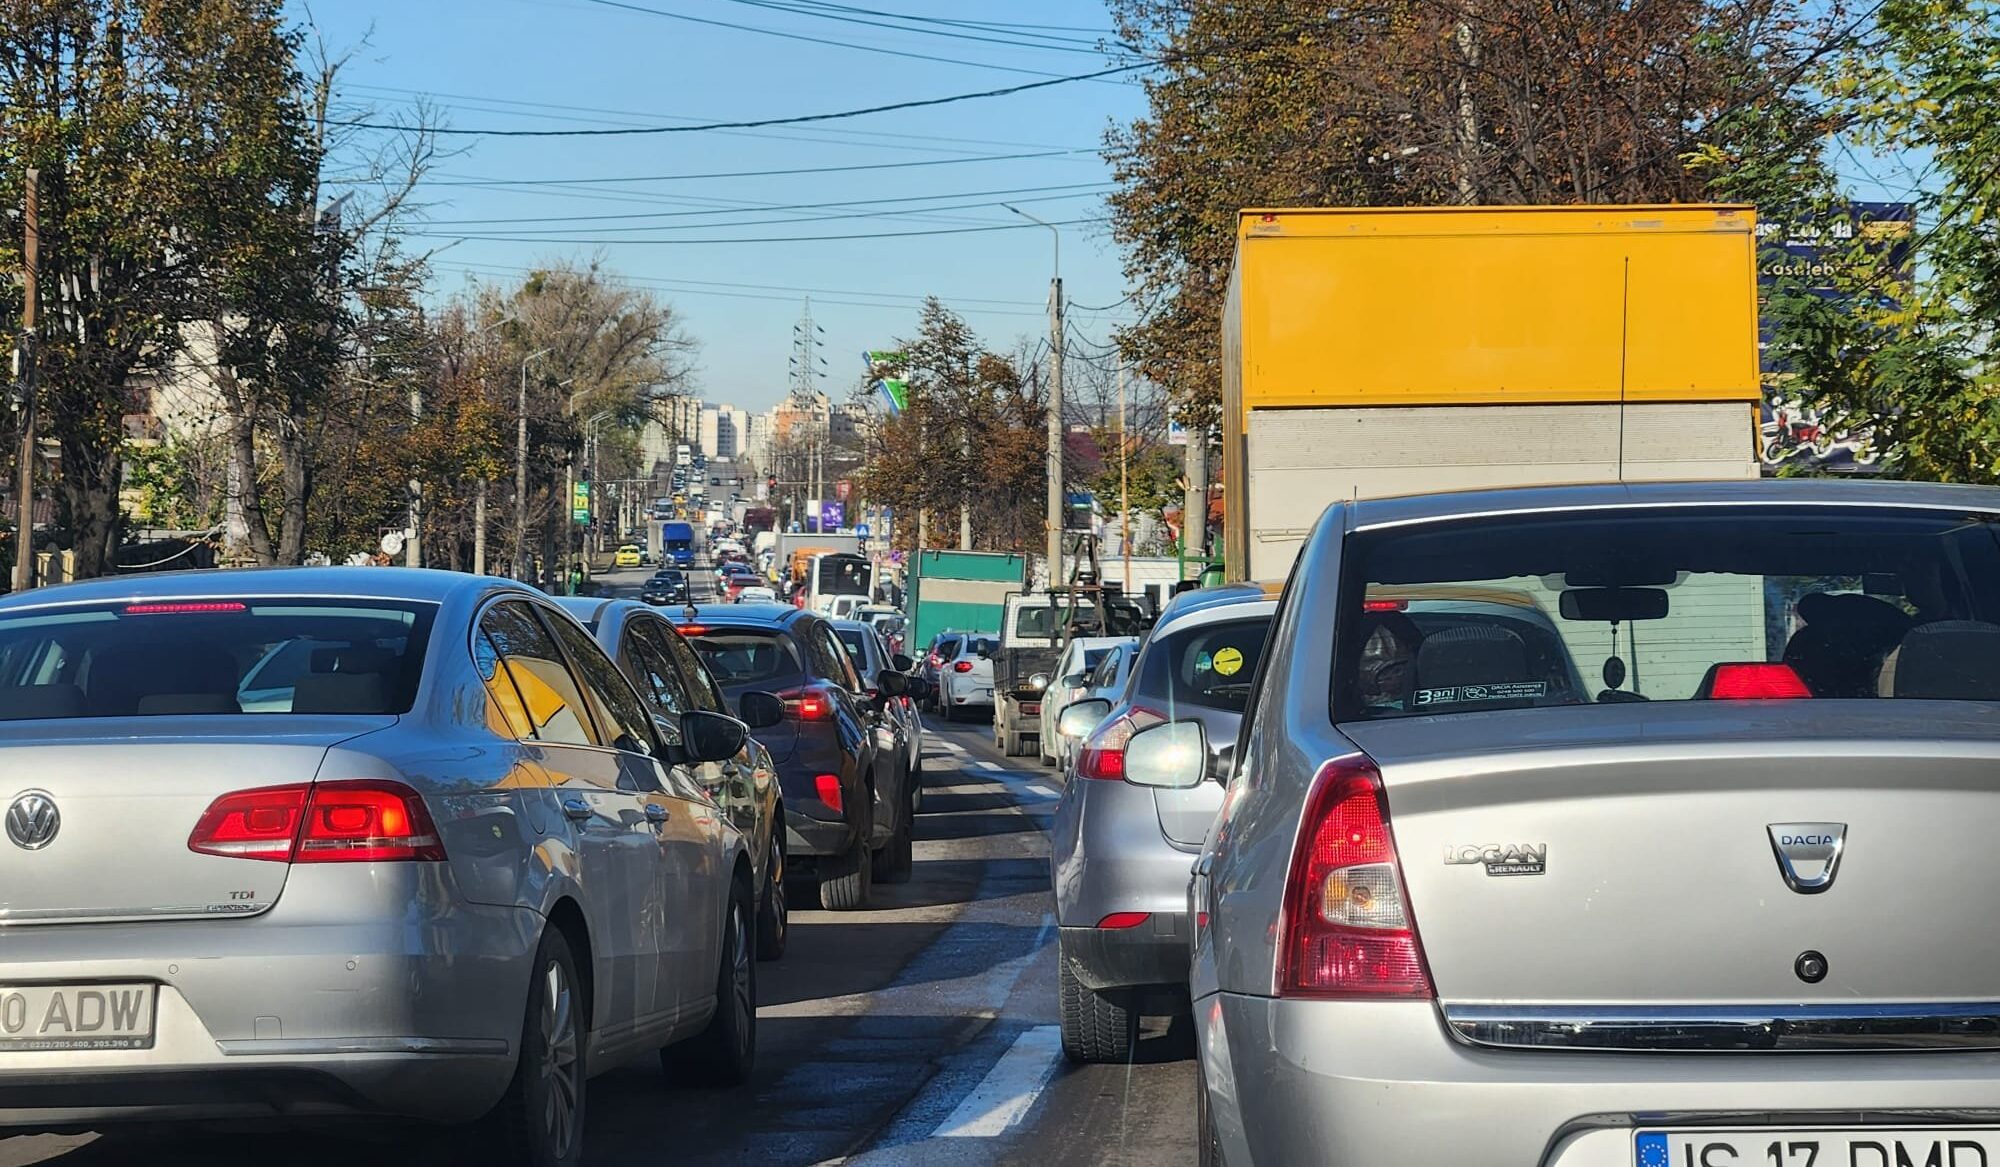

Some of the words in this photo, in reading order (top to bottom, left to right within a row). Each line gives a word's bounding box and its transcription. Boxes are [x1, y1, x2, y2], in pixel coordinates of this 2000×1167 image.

[1418, 690, 1432, 704] 3
[1781, 835, 1833, 846] DACIA
[1443, 843, 1547, 865] LOGAN
[1495, 864, 1542, 873] RENAULT
[229, 890, 255, 900] TDI
[40, 989, 143, 1032] ADW
